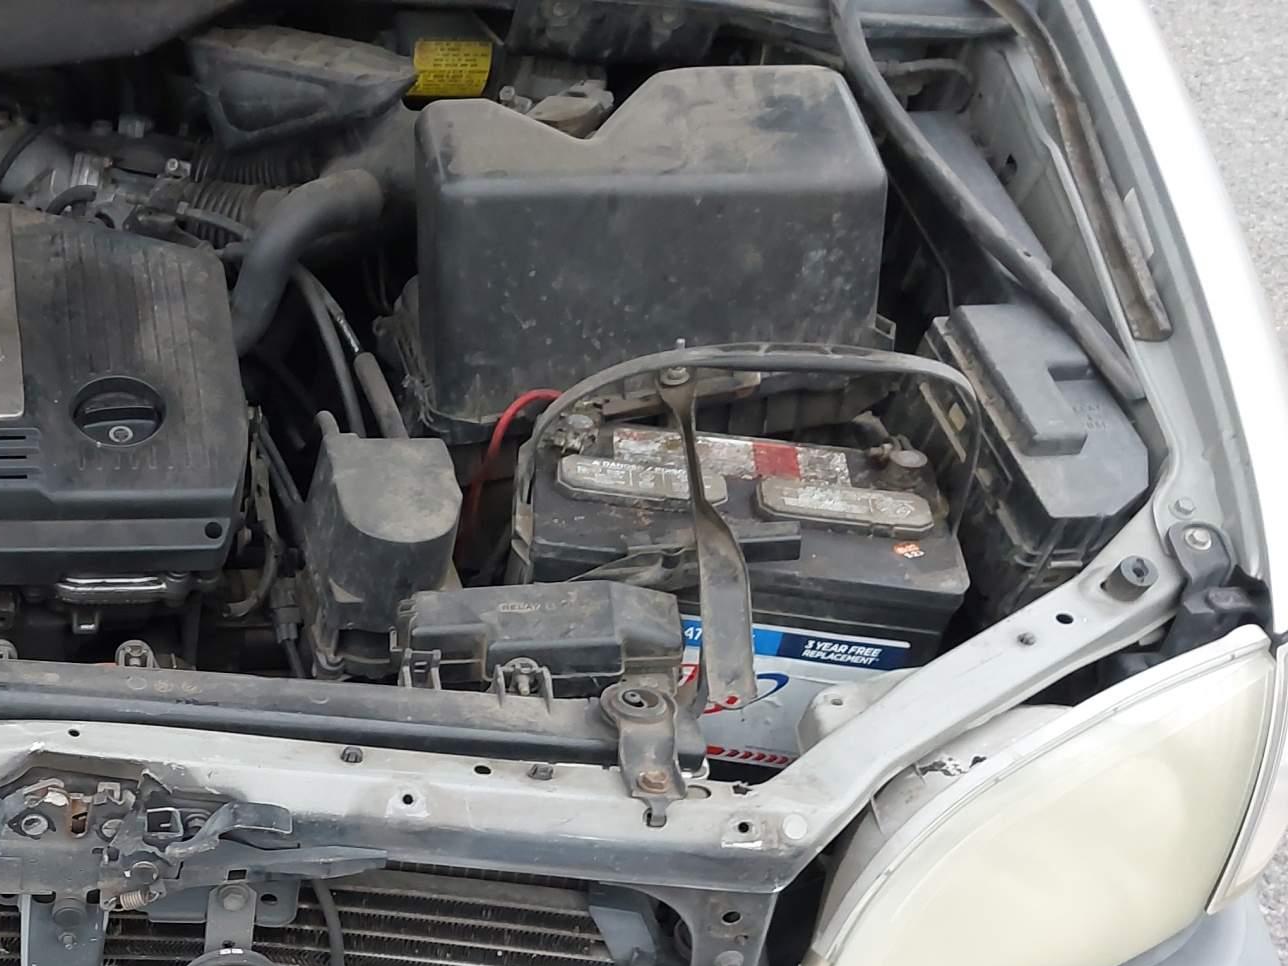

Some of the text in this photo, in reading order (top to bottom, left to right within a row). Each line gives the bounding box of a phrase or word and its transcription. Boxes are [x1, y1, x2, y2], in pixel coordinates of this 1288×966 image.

[804, 639, 883, 658] 3 YEAR FREE
